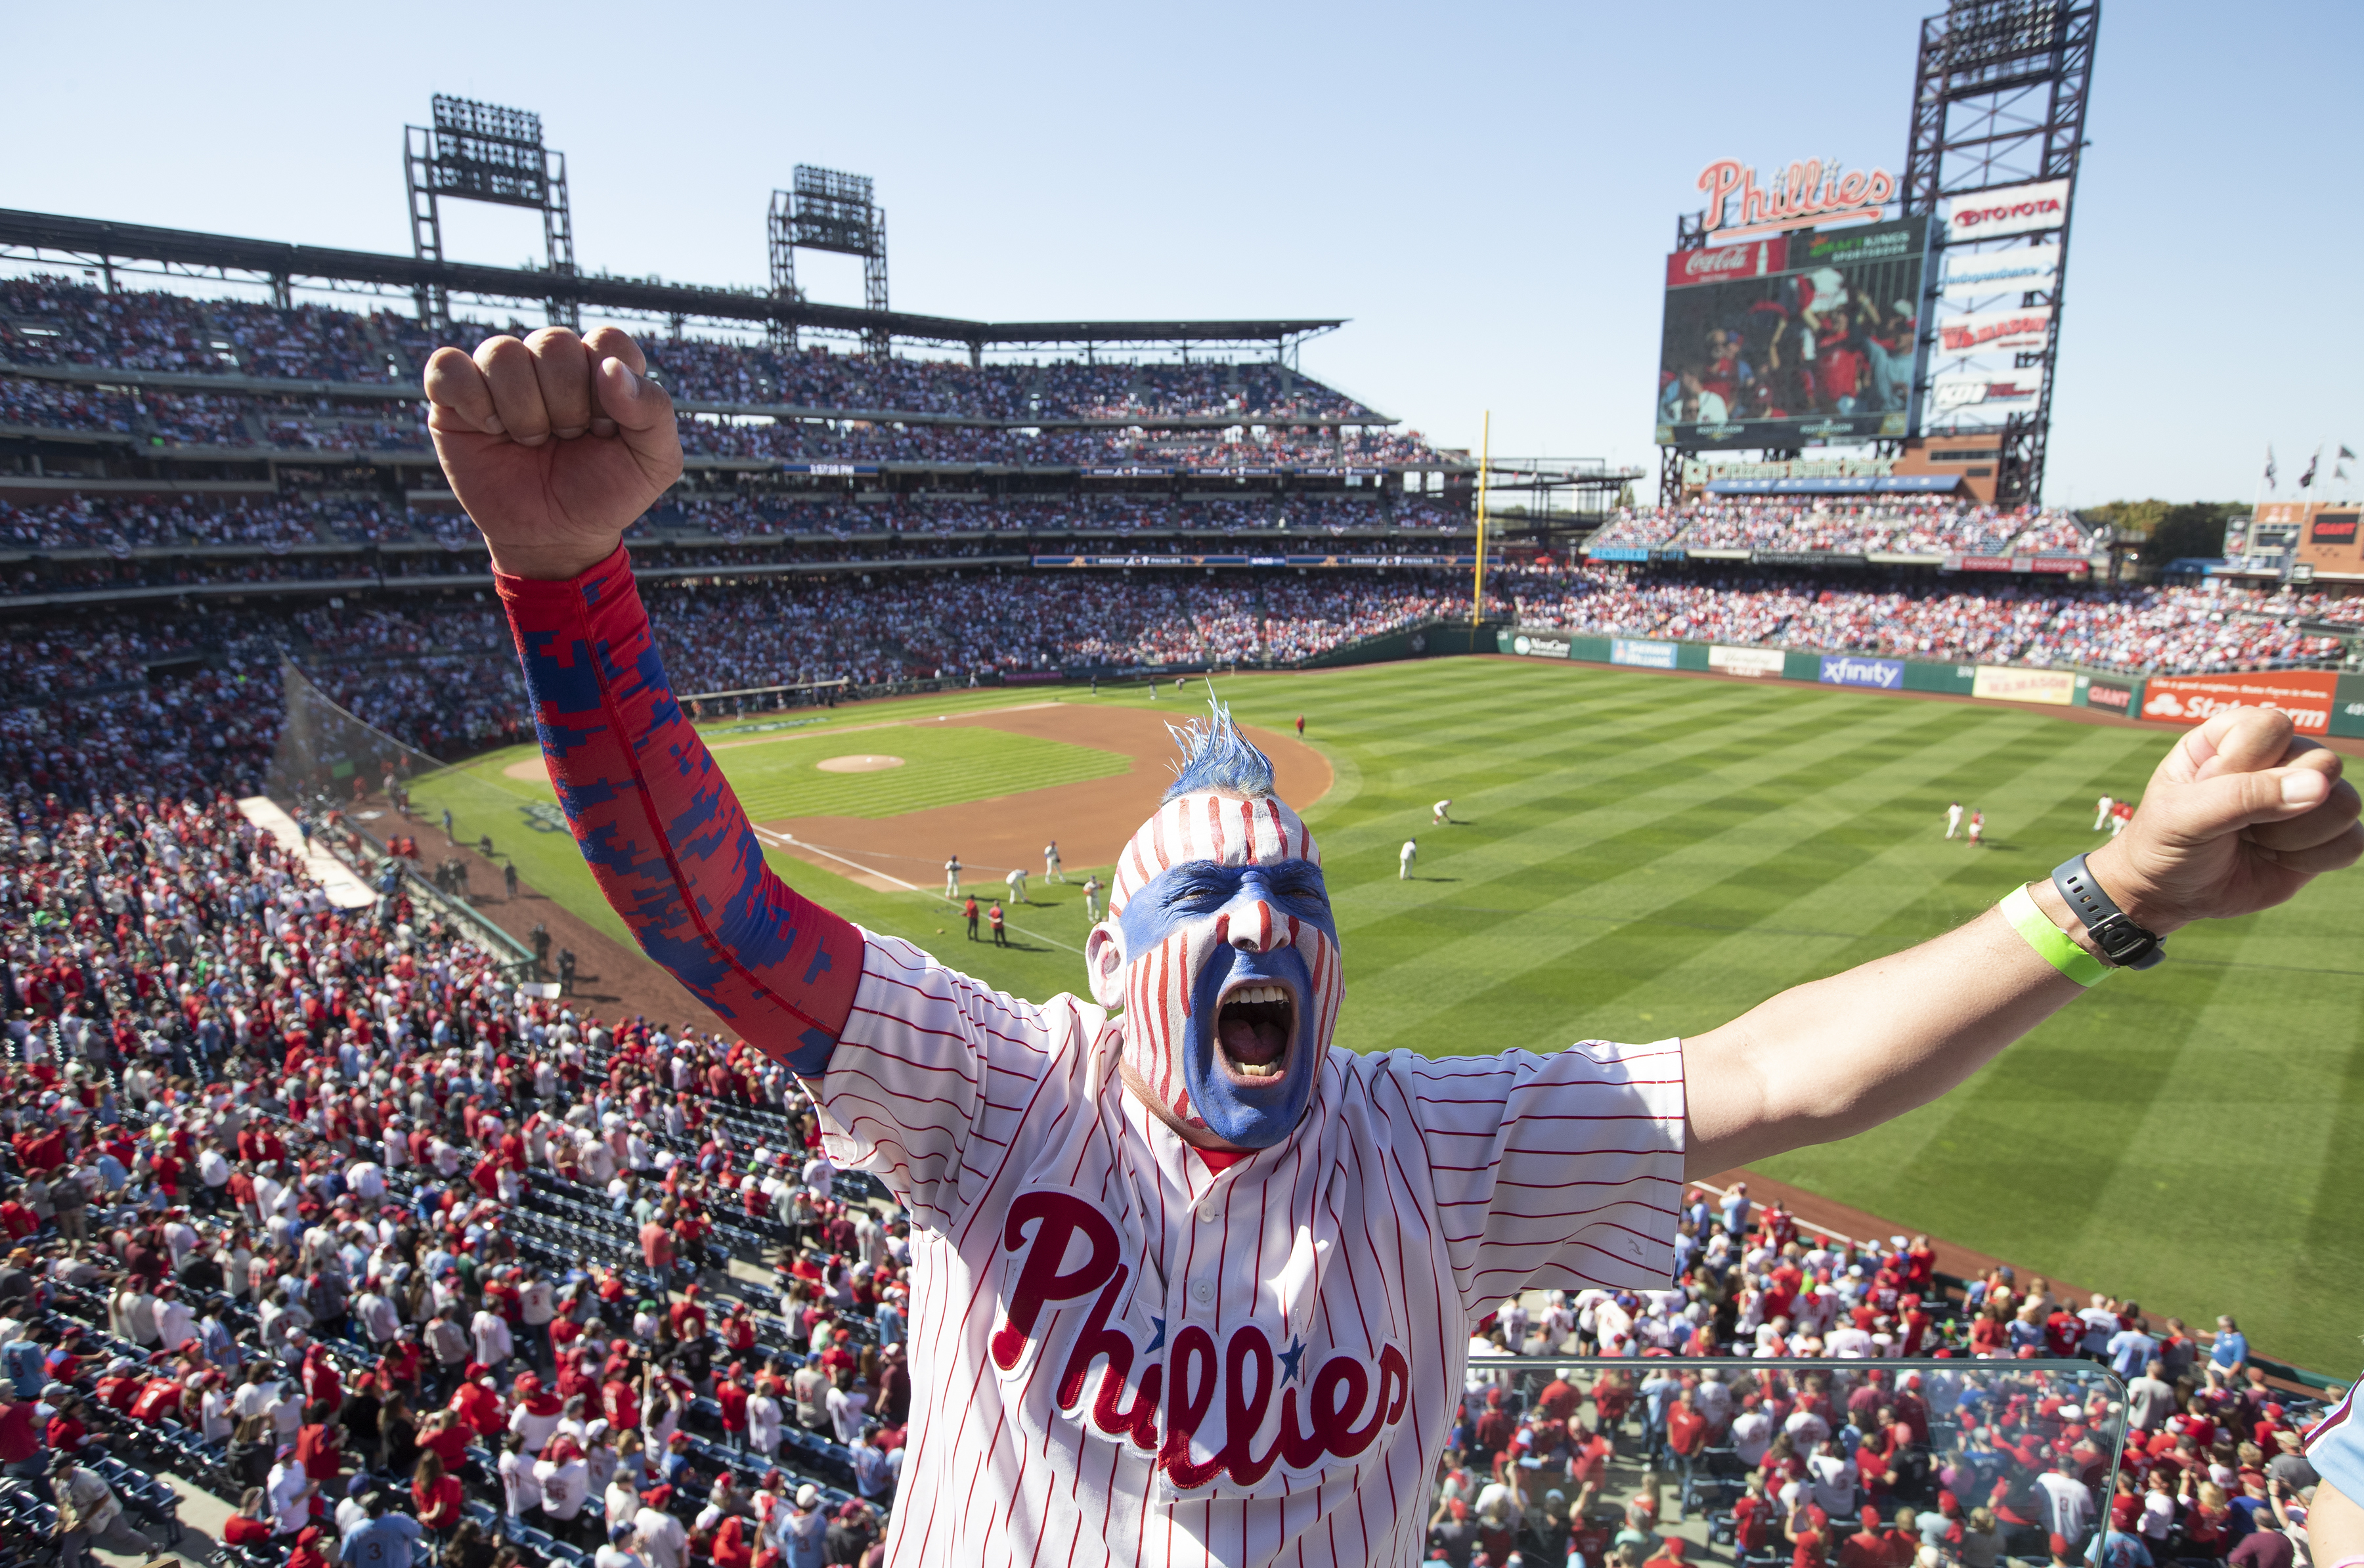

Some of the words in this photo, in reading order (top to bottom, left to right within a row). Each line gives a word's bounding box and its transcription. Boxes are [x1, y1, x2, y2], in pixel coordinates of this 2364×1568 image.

[1696, 157, 1895, 230] Phillies
[1982, 199, 2060, 221] TOYOTA
[1712, 462, 1788, 480] Citizens
[1789, 459, 1843, 478] Bank
[1845, 458, 1894, 477] Park
[2314, 522, 2357, 535] GIANT
[1823, 657, 1900, 688] xfinity
[2151, 678, 2170, 688] Like
[2178, 681, 2200, 691] good
[2088, 685, 2132, 708] GIANT
[990, 1188, 1410, 1491] Phillies
[12, 1362, 25, 1378] 3
[368, 1542, 383, 1561] 3
[2113, 1550, 2130, 1568] 3
